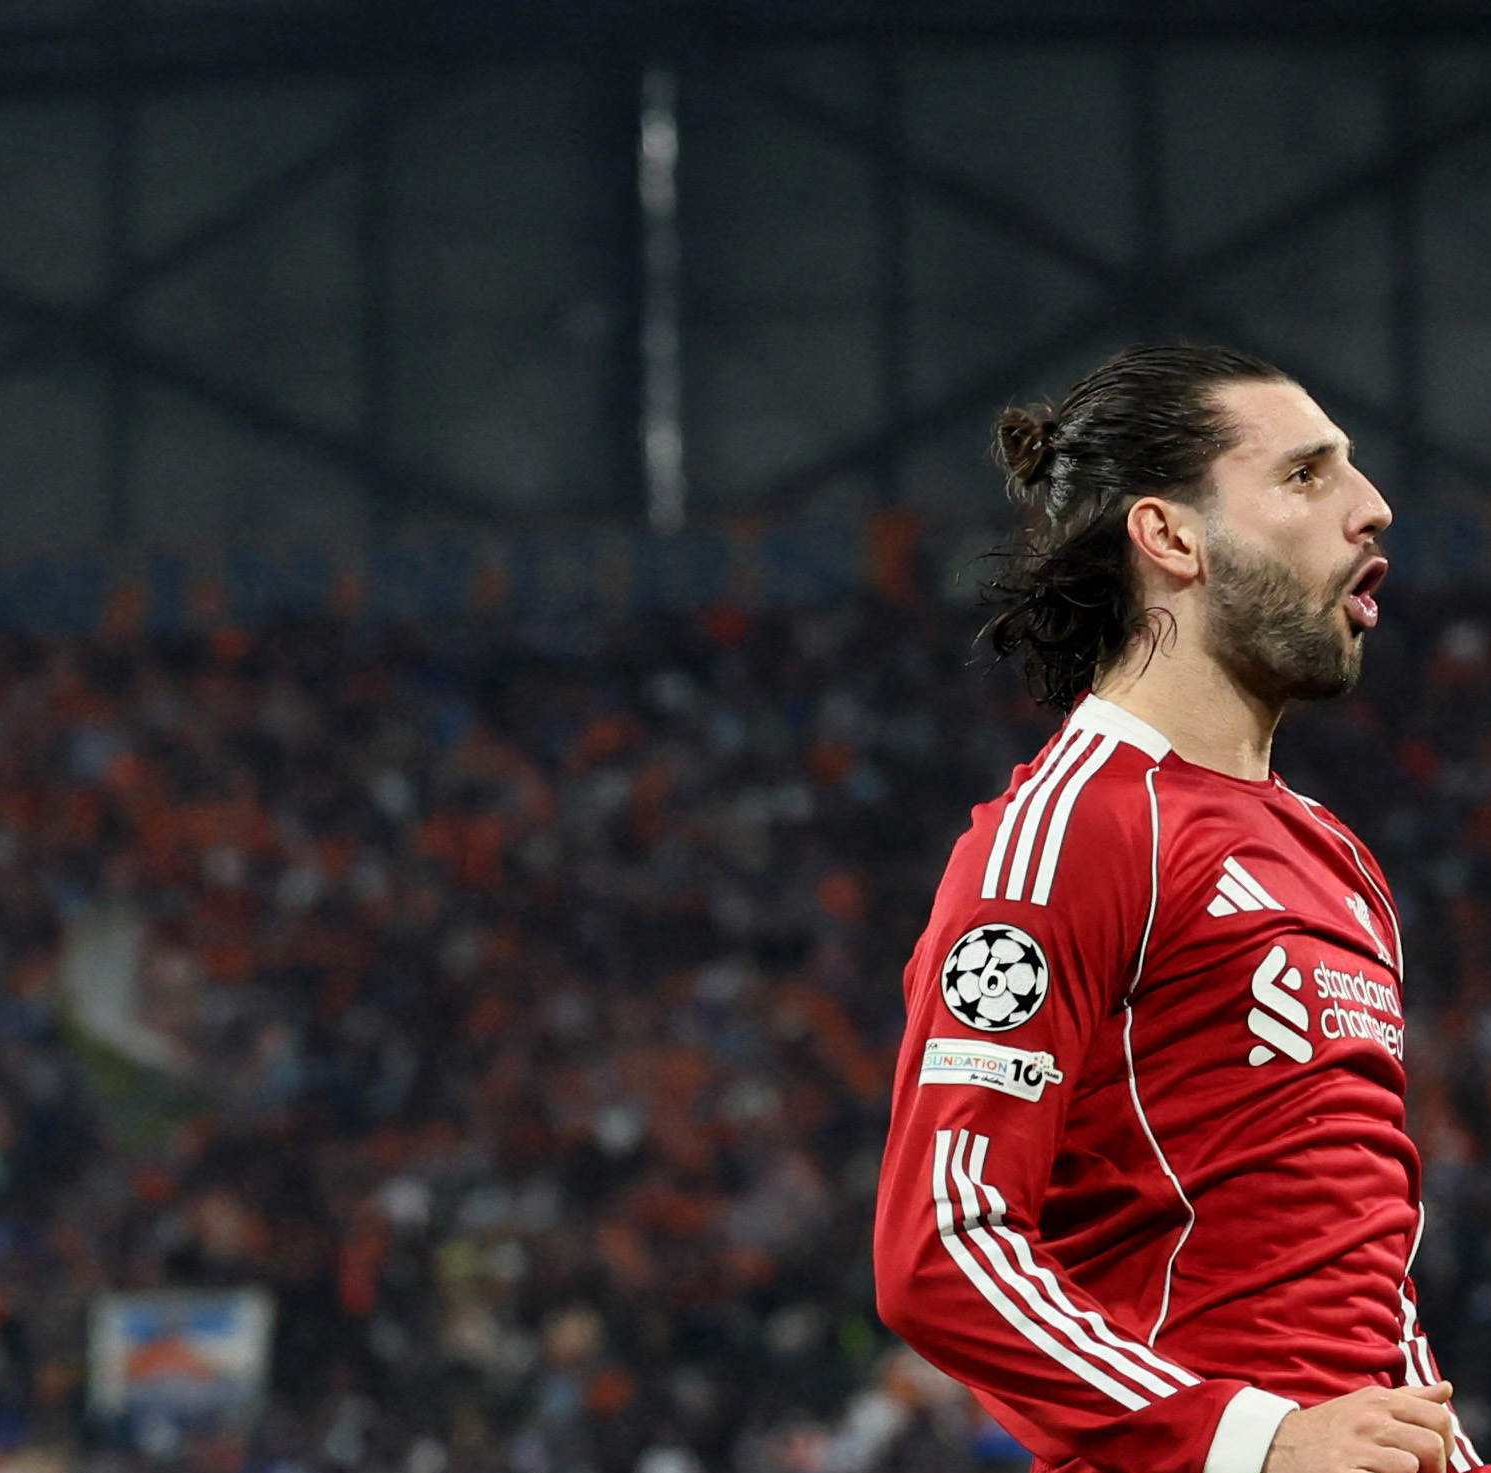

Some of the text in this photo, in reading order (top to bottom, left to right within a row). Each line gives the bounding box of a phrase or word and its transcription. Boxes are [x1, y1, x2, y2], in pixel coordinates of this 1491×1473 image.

[978, 956, 1008, 999] 6
[1313, 960, 1403, 1019] standard
[1320, 1001, 1405, 1061] chartered
[924, 1055, 1008, 1074] OUNDATION
[1011, 1058, 1043, 1087] 10
